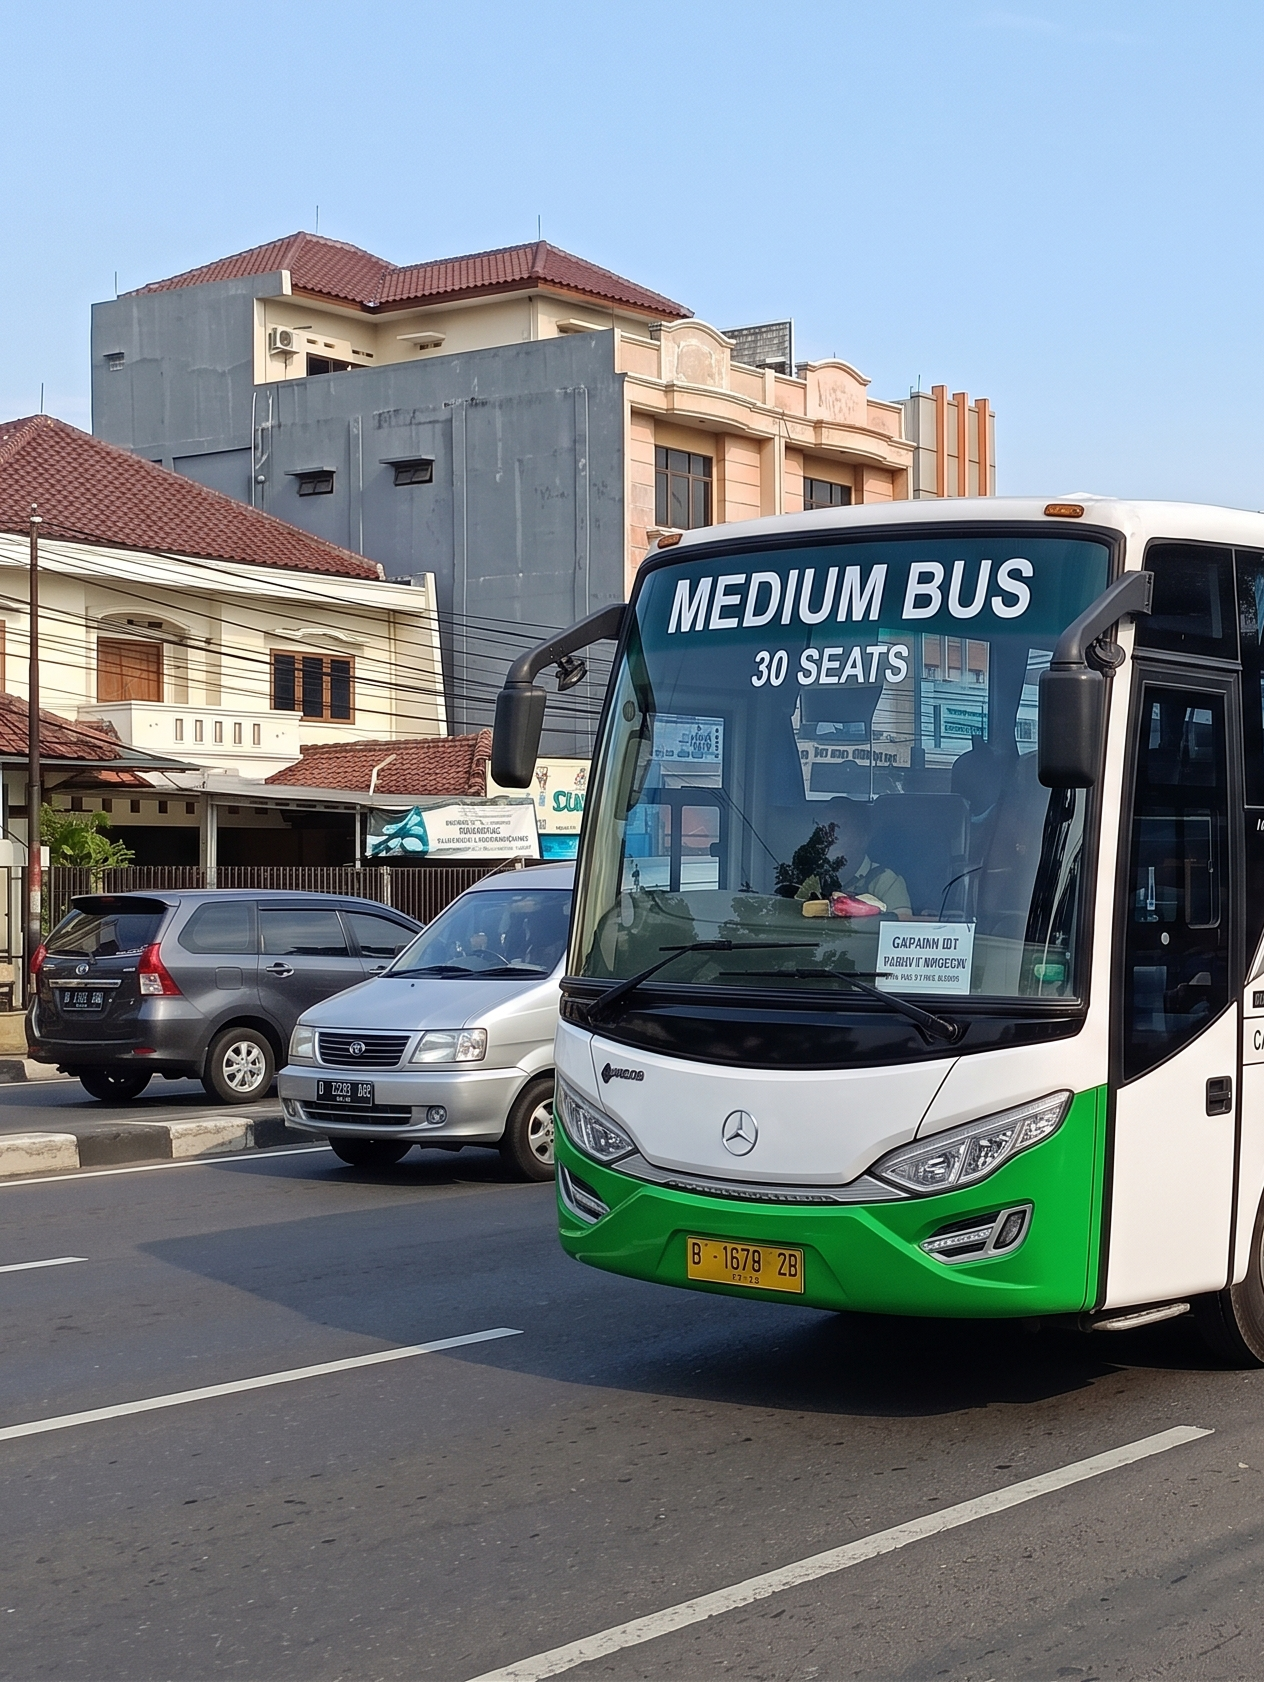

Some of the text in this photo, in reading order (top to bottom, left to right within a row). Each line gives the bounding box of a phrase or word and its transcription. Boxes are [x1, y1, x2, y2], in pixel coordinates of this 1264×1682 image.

[667, 557, 1034, 635] MEDIUM BUS
[751, 644, 910, 688] 30 SEATS
[692, 1242, 702, 1265] B
[722, 1245, 762, 1273] 1678
[777, 1252, 799, 1278] 2B
